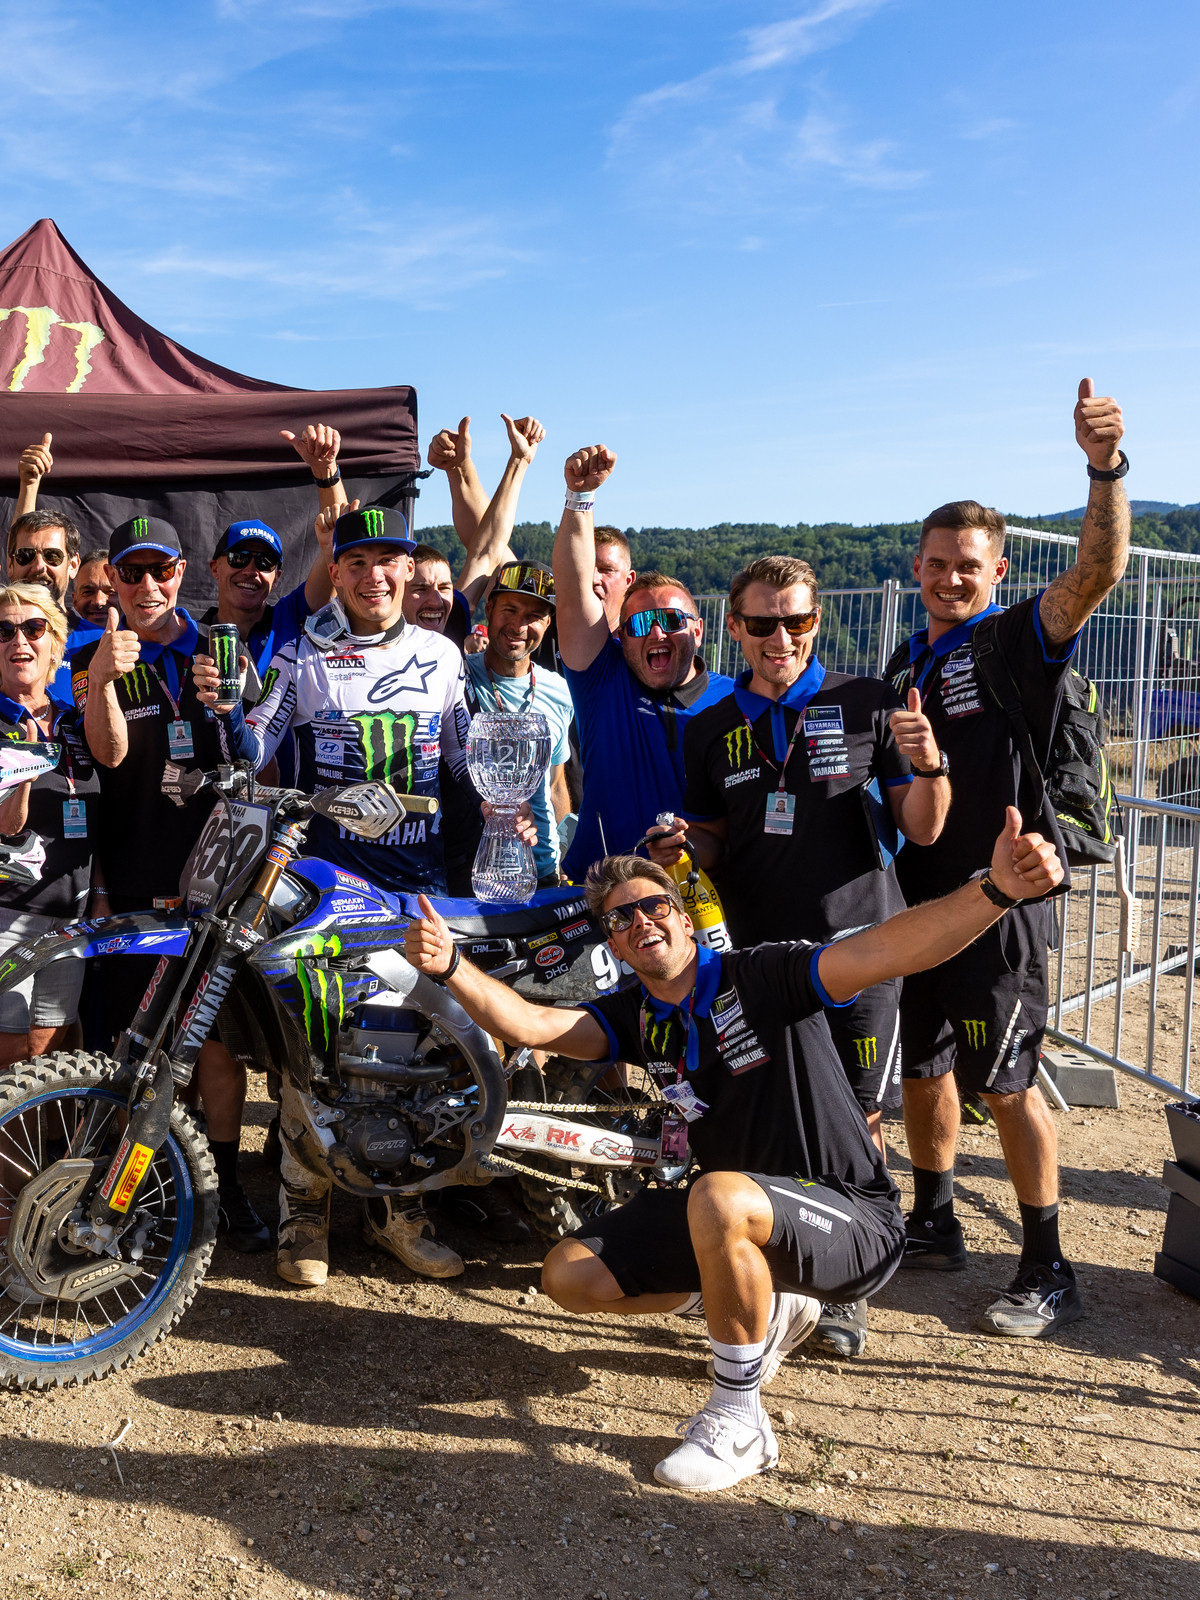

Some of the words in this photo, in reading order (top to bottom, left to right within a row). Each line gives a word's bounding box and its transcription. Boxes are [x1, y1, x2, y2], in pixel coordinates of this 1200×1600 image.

[328, 659, 364, 668] WILVO
[125, 705, 159, 716] SEMAKIN
[132, 710, 160, 720] DEPAN
[945, 700, 980, 716] YAMALUBE
[815, 722, 840, 730] YAMAHA
[498, 745, 514, 766] 2
[724, 767, 760, 782] SEMAKIN
[812, 765, 849, 777] YAMALUBE
[732, 773, 760, 786] DEPAN
[328, 805, 359, 816] ACERBIS
[339, 875, 368, 891] WILVO
[331, 897, 364, 906] SEMAKIN
[343, 904, 365, 912] DEPAN
[554, 900, 590, 921] YAMAH
[564, 924, 590, 939] WILVO
[98, 938, 131, 952] VERTEX
[545, 963, 568, 980] DHG
[181, 972, 209, 1030] KYB
[183, 965, 237, 1048] YAMAHA
[1010, 1029, 1029, 1060] YAMAHA
[729, 1047, 765, 1069] YAMALUBE
[367, 1139, 407, 1151] GYTR
[547, 1128, 583, 1147] RK
[103, 1141, 129, 1197] BRAKING
[115, 1150, 148, 1208] PIRELLI
[807, 1210, 833, 1231] YAMAHA
[72, 1263, 120, 1288] ACERBIS
